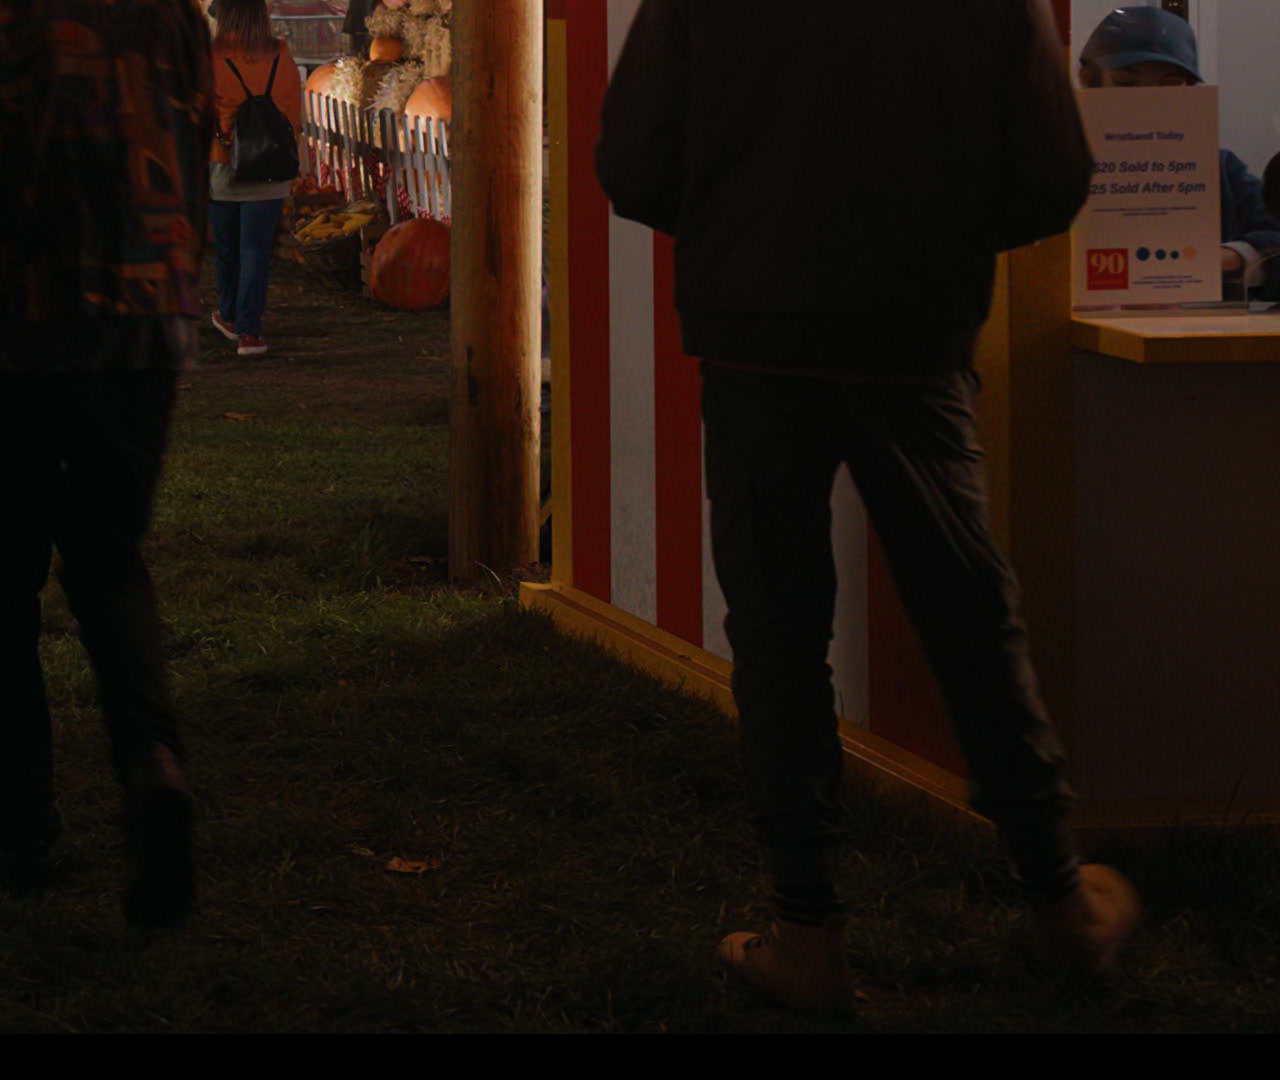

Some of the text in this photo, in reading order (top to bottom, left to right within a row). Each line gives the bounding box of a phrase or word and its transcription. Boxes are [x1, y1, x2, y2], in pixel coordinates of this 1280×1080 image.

[1156, 130, 1185, 142] Today
[1119, 160, 1149, 174] Sold
[1152, 160, 1166, 173] to
[1168, 160, 1197, 175] 5pm
[1110, 182, 1139, 195] Sold
[1142, 181, 1174, 194] After
[1178, 181, 1206, 196] 5pm
[1090, 253, 1125, 274] 90
